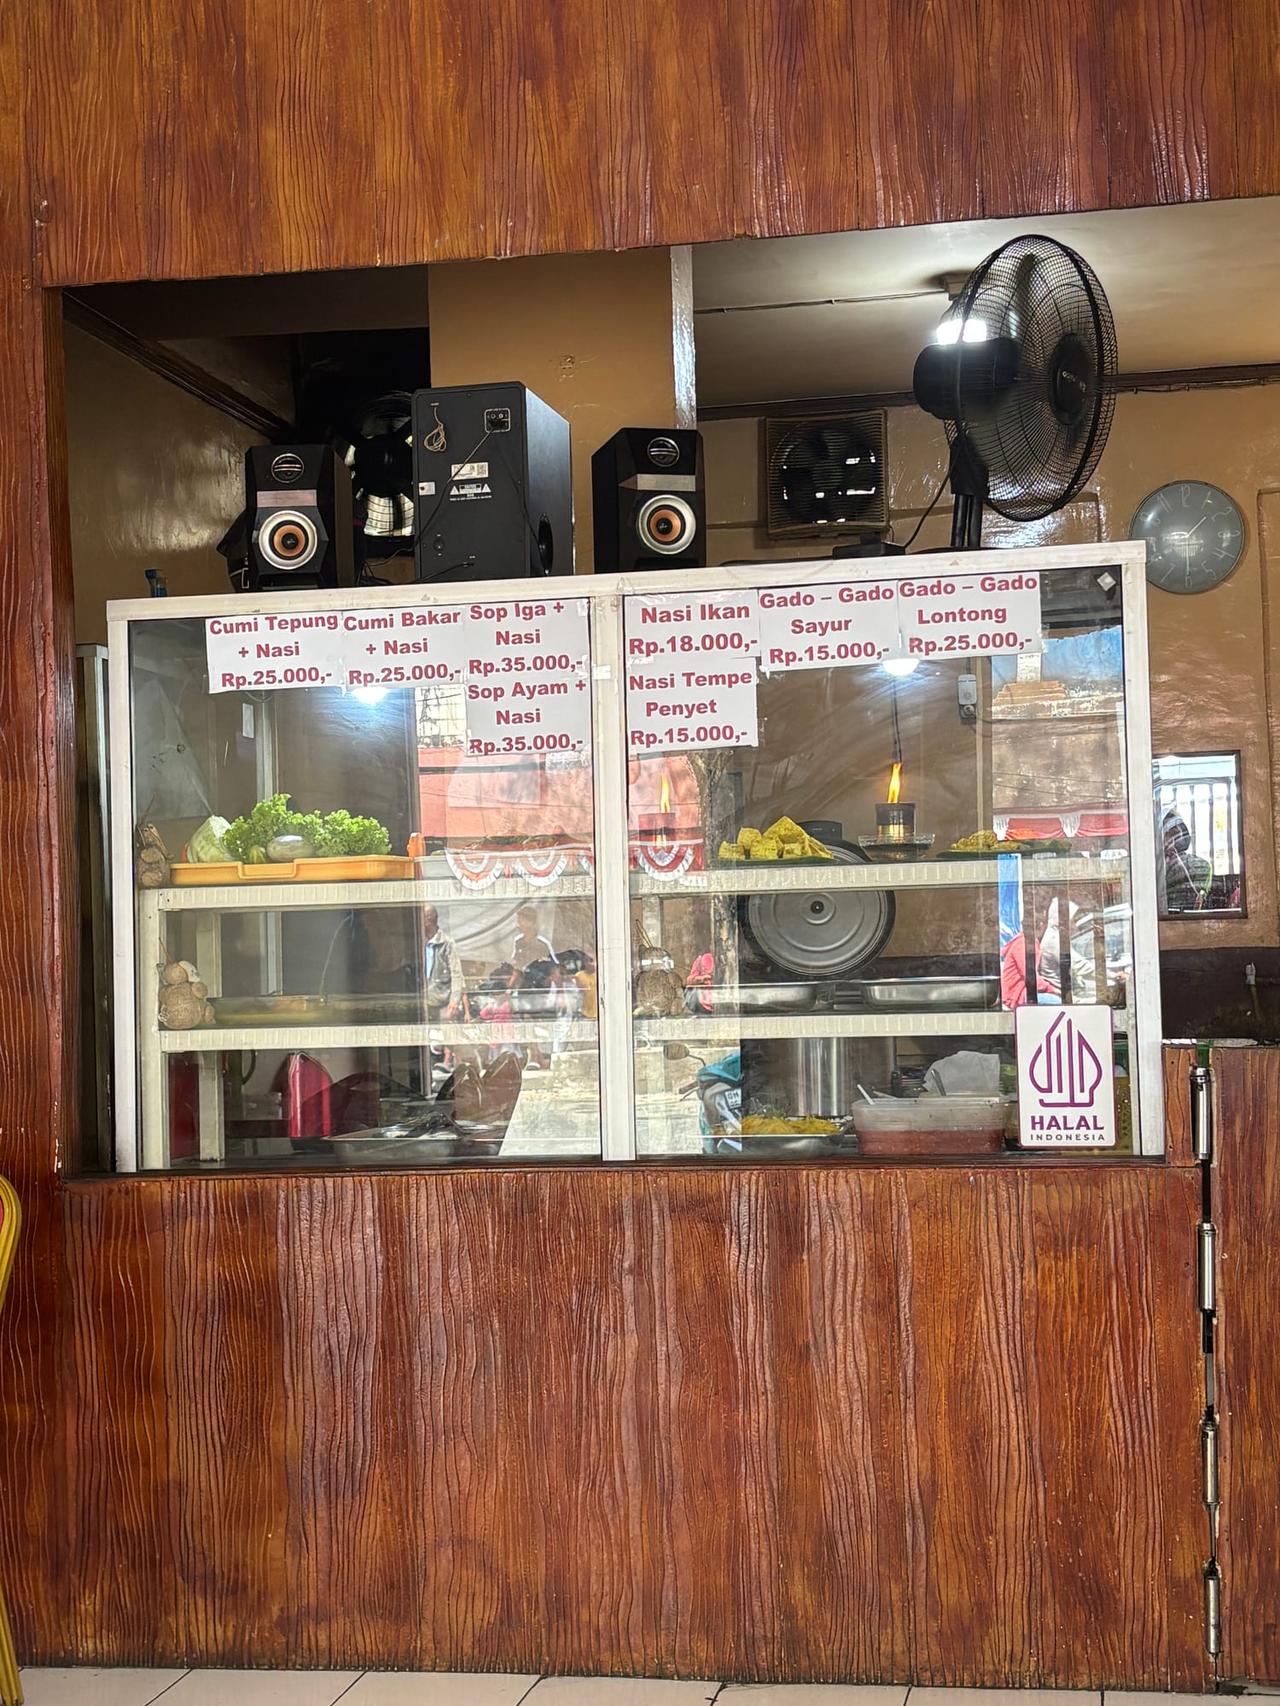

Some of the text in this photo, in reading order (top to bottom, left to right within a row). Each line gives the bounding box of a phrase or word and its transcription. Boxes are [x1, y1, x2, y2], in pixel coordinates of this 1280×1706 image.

[899, 580, 956, 597] Gado
[980, 575, 1038, 593] Gado
[760, 591, 815, 609] Gado
[839, 585, 894, 604] Gado
[344, 610, 461, 631] Cumi Bakar
[470, 604, 507, 623] Sop
[515, 602, 546, 619] Iga
[641, 602, 750, 624] Nasi Ikan
[918, 607, 1007, 626] Lontong
[209, 614, 338, 635] Cumi Tepung
[791, 618, 852, 636] Sayur
[384, 638, 429, 655] Nasi
[496, 629, 541, 645] Nasi
[629, 632, 758, 657] Rp.18.000,-
[909, 633, 1032, 657] Rp.25.000,-
[256, 641, 301, 658] Nasi
[770, 643, 890, 666] Rp.15.000,-
[349, 664, 461, 687] Rp.25.000,-
[469, 654, 583, 676] Rp.35.000,-
[221, 667, 332, 689] Rp.25.000,-
[629, 670, 752, 691] Nasi Tempe
[467, 684, 505, 703] Sop
[512, 681, 569, 700] Ayam
[496, 708, 541, 725] Nasi
[646, 699, 717, 718] Penyet
[469, 734, 583, 756] Rp.35.000,-
[631, 726, 747, 747] Rp.15.000,-
[1031, 1116, 1104, 1130] HALAL
